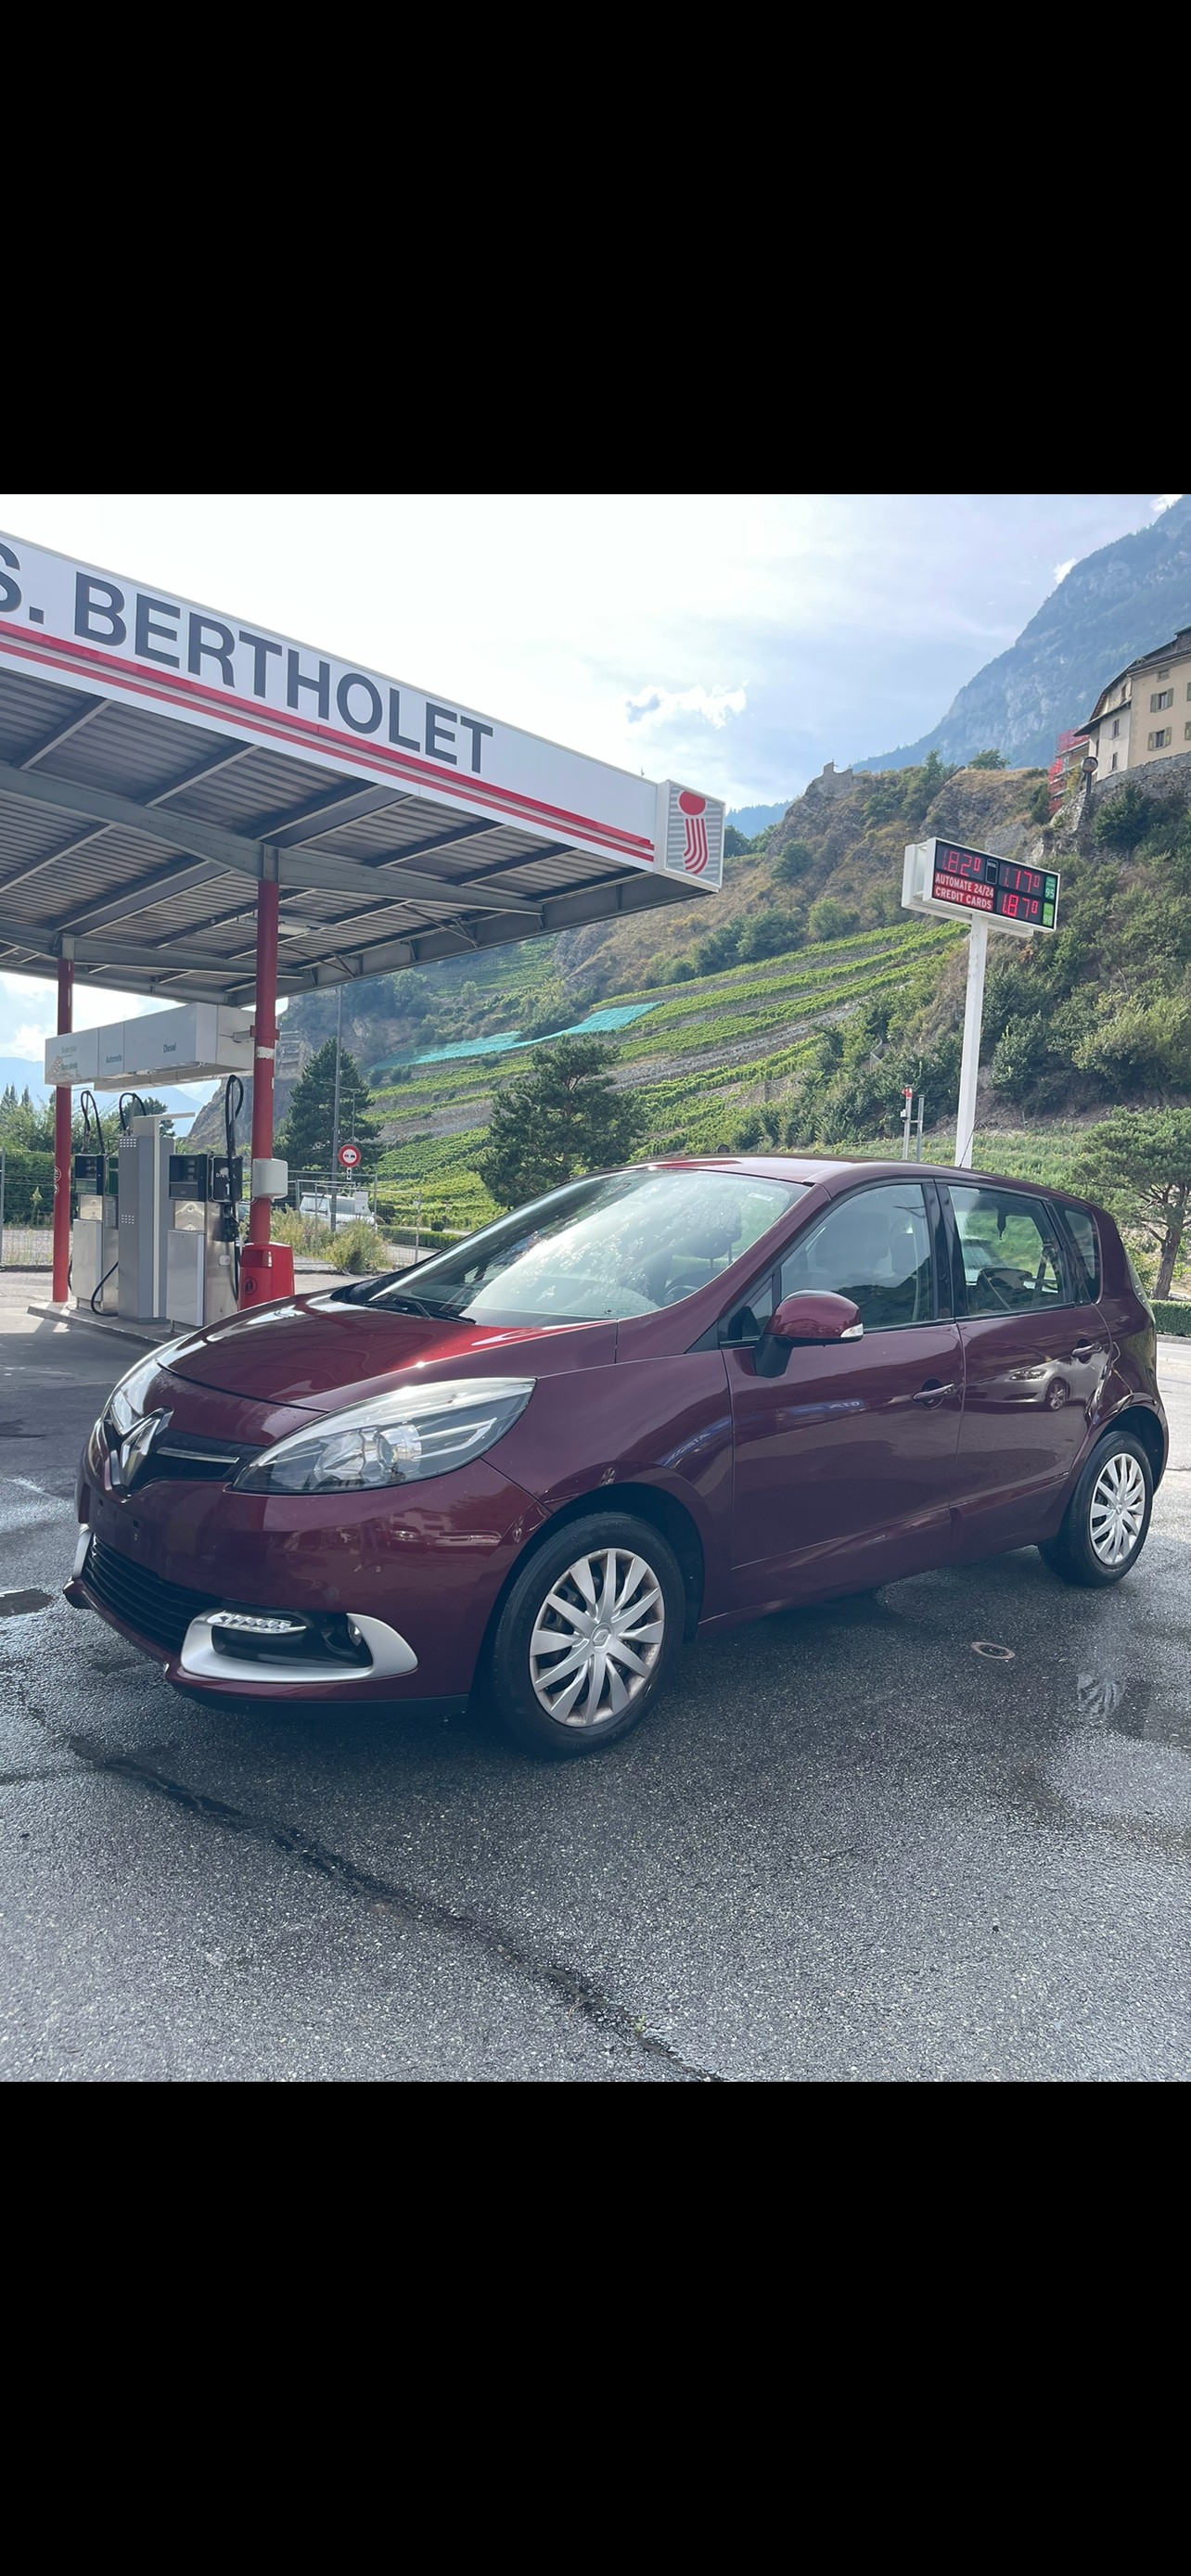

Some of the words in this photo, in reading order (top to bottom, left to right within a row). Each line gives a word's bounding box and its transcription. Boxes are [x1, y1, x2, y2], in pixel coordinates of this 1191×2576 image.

[74, 571, 493, 773] BERTHOLET
[935, 873, 972, 891] AUTOMATE
[973, 884, 994, 899] 24/24
[935, 886, 965, 902] CREDIT
[966, 895, 993, 910] CARDS
[1044, 888, 1055, 899] 95
